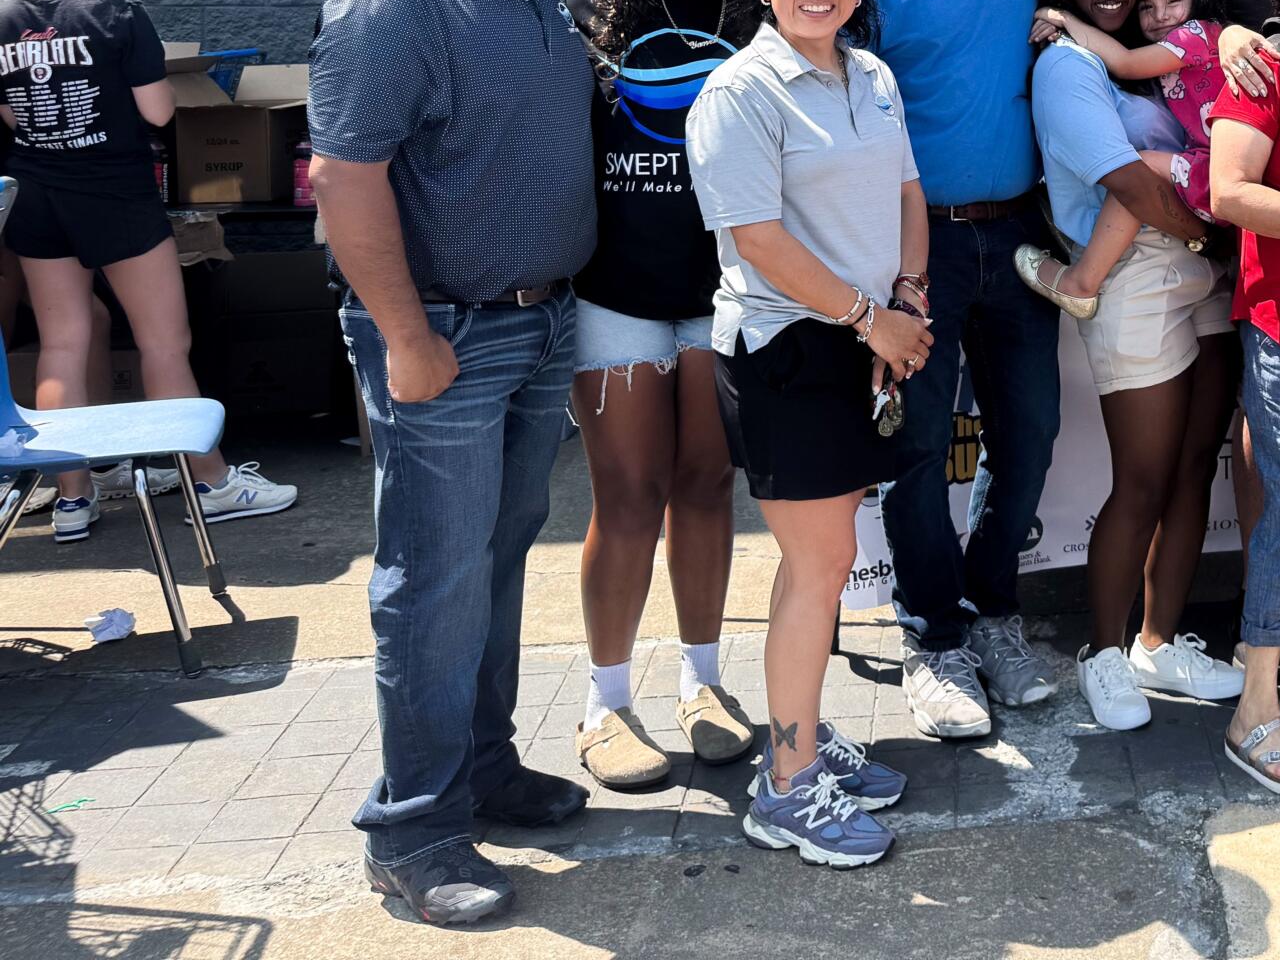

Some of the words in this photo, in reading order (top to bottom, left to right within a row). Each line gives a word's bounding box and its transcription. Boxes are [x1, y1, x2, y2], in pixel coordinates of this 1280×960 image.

[66, 131, 108, 149] FINALS
[204, 161, 244, 173] SYRUP
[605, 151, 681, 177] SWEPT
[603, 180, 636, 192] We'll
[641, 181, 683, 193] Make
[847, 559, 892, 583] nesb
[846, 579, 875, 591] EDIA
